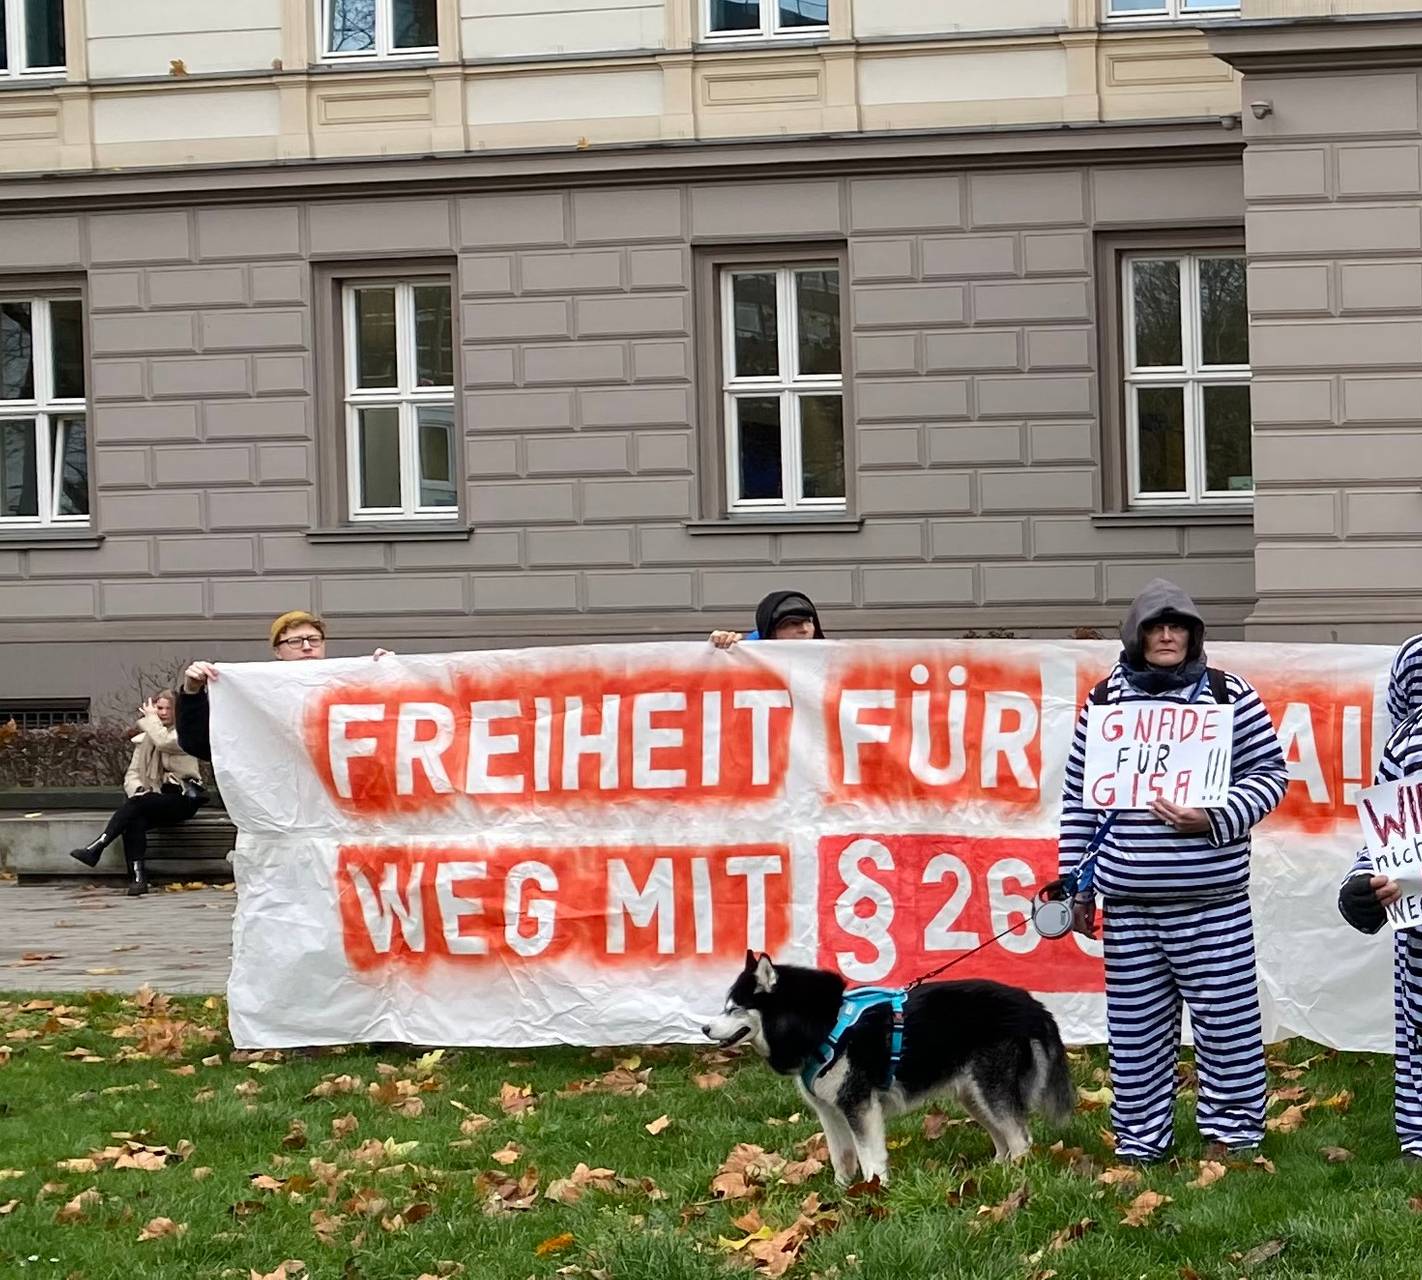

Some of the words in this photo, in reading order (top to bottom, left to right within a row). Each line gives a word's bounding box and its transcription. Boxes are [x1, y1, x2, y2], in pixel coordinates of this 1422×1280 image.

[327, 689, 793, 799] FREIHEIT
[838, 663, 1040, 789] FÜR
[1101, 707, 1221, 743] GNADE
[1117, 743, 1171, 774] FÜR
[1091, 770, 1193, 807] GISA
[345, 860, 560, 958] WEG
[604, 855, 782, 955] MIT
[921, 851, 1104, 958] 26
